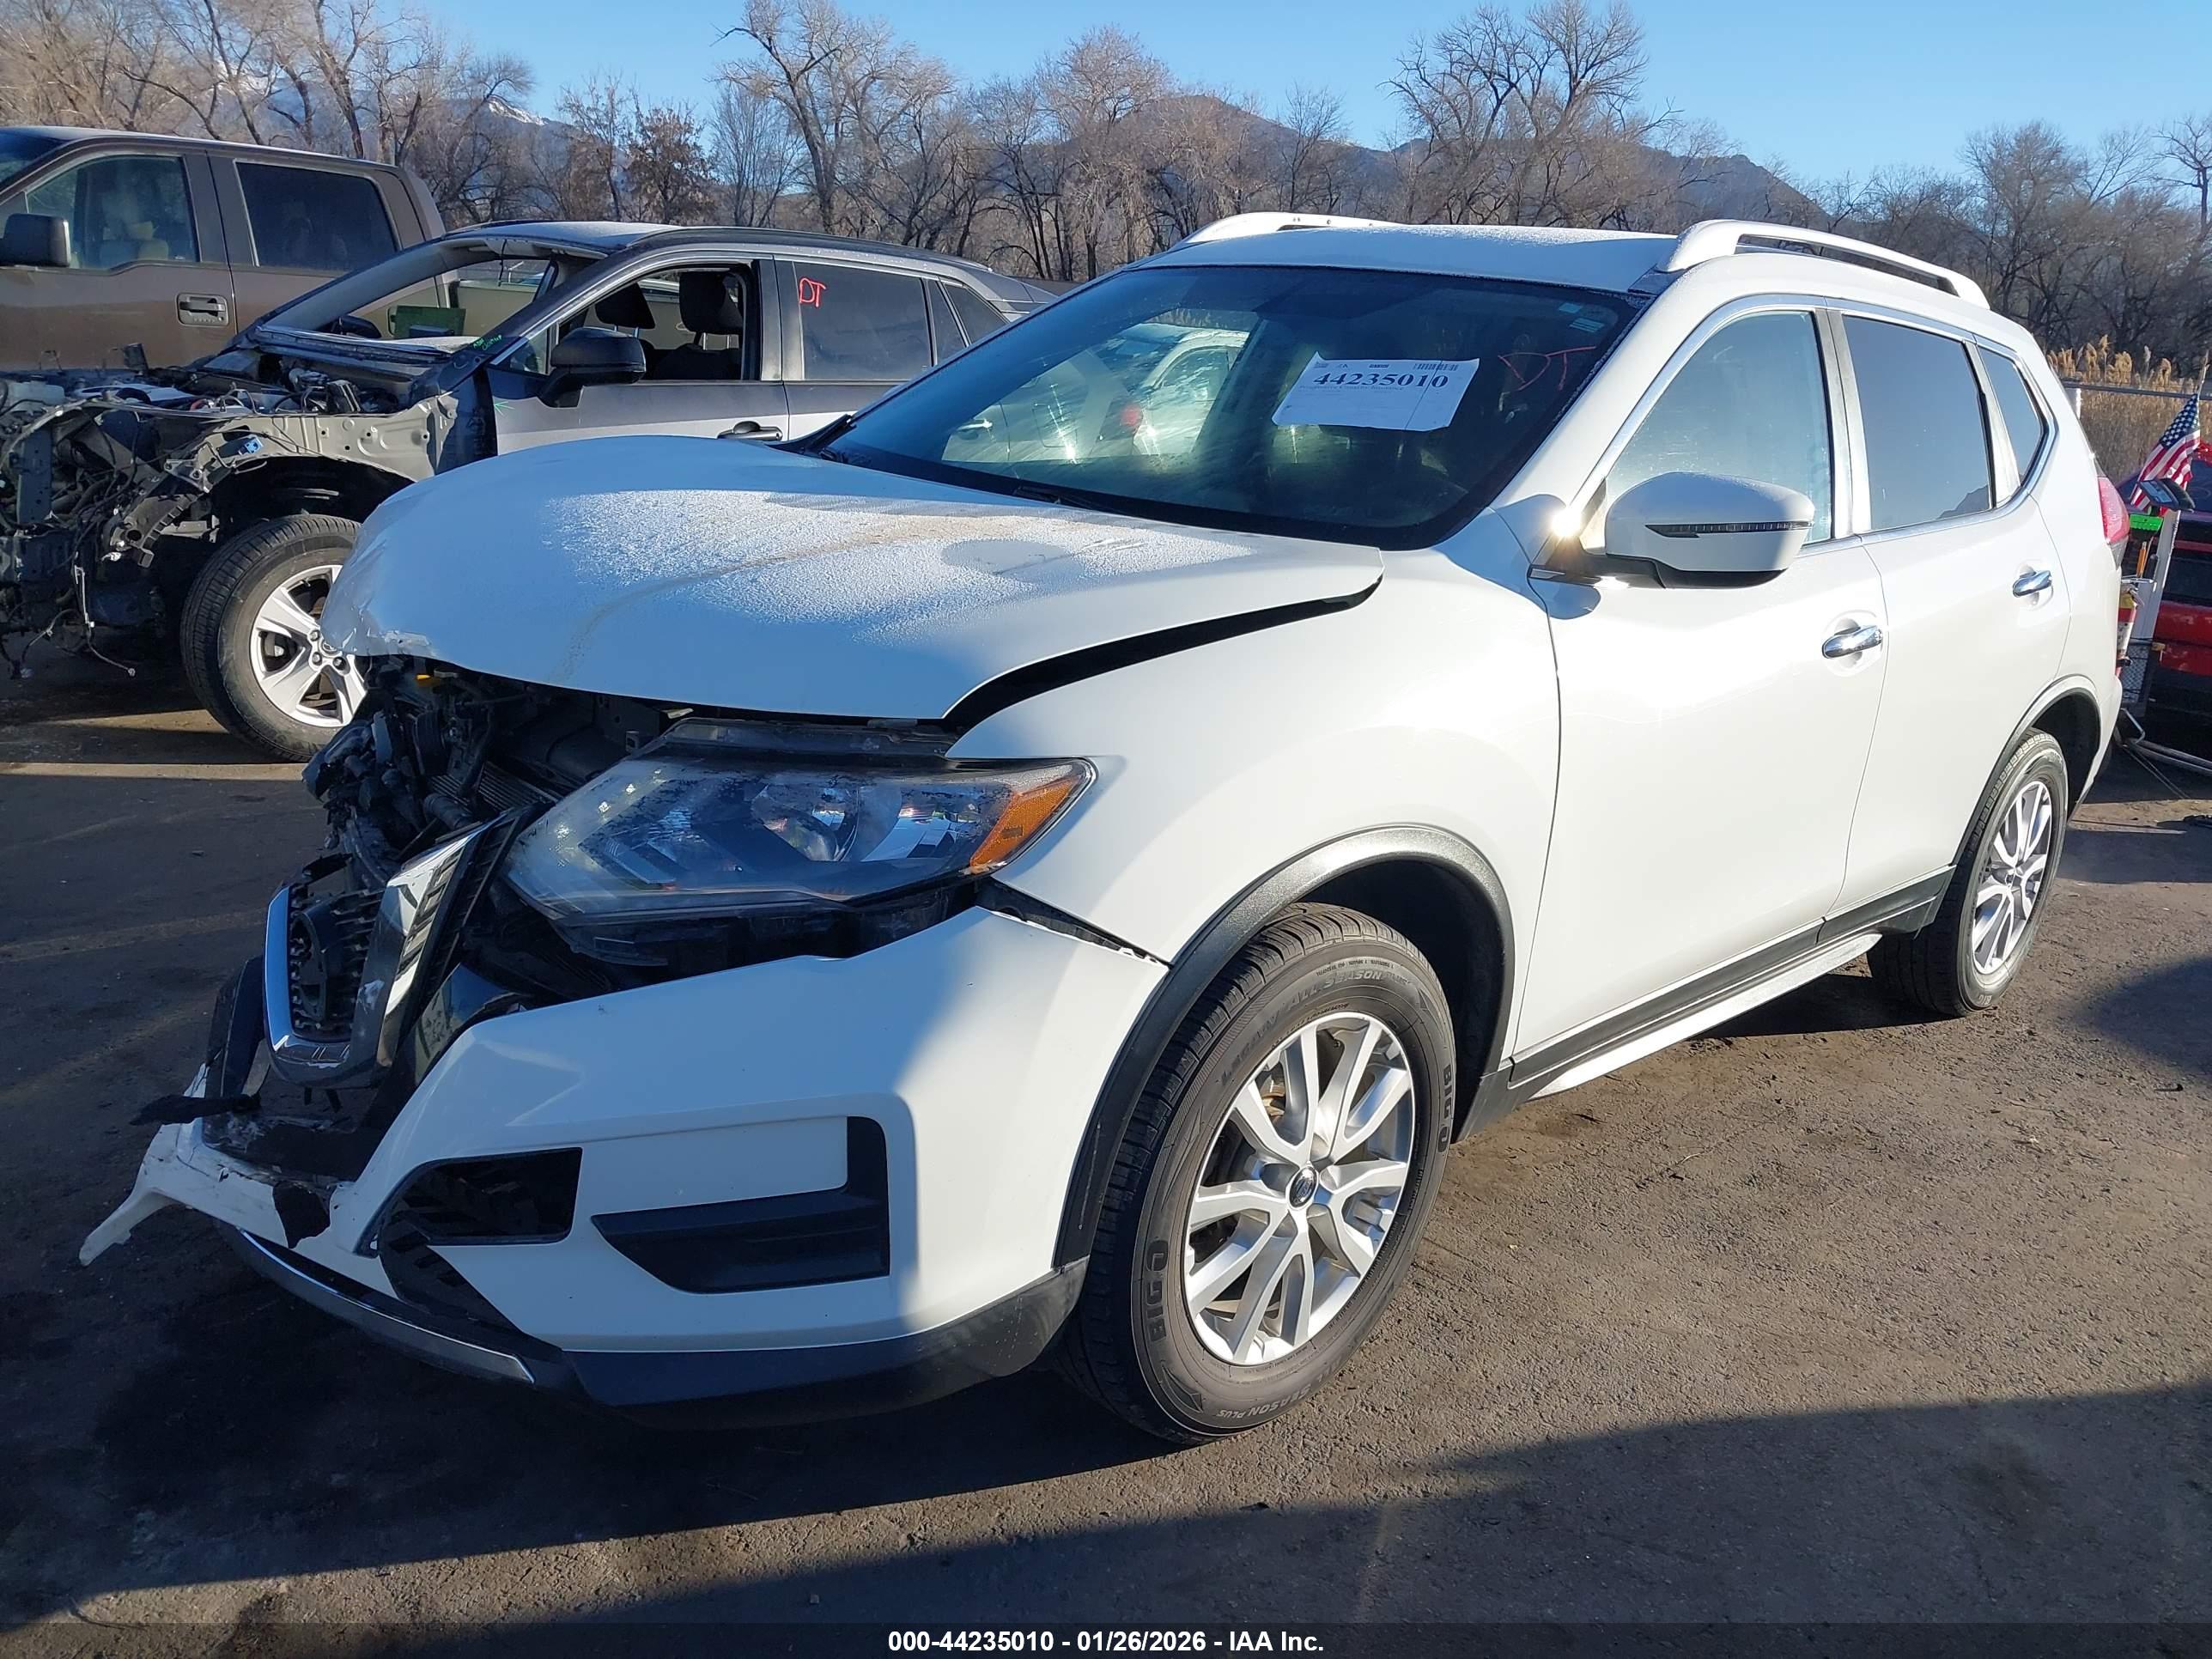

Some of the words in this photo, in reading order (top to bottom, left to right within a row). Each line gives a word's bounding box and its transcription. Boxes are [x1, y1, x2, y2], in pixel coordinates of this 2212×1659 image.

[799, 277, 826, 307] DT
[1313, 373, 1449, 388] 44235010
[1216, 1409, 1246, 1419] PLUS
